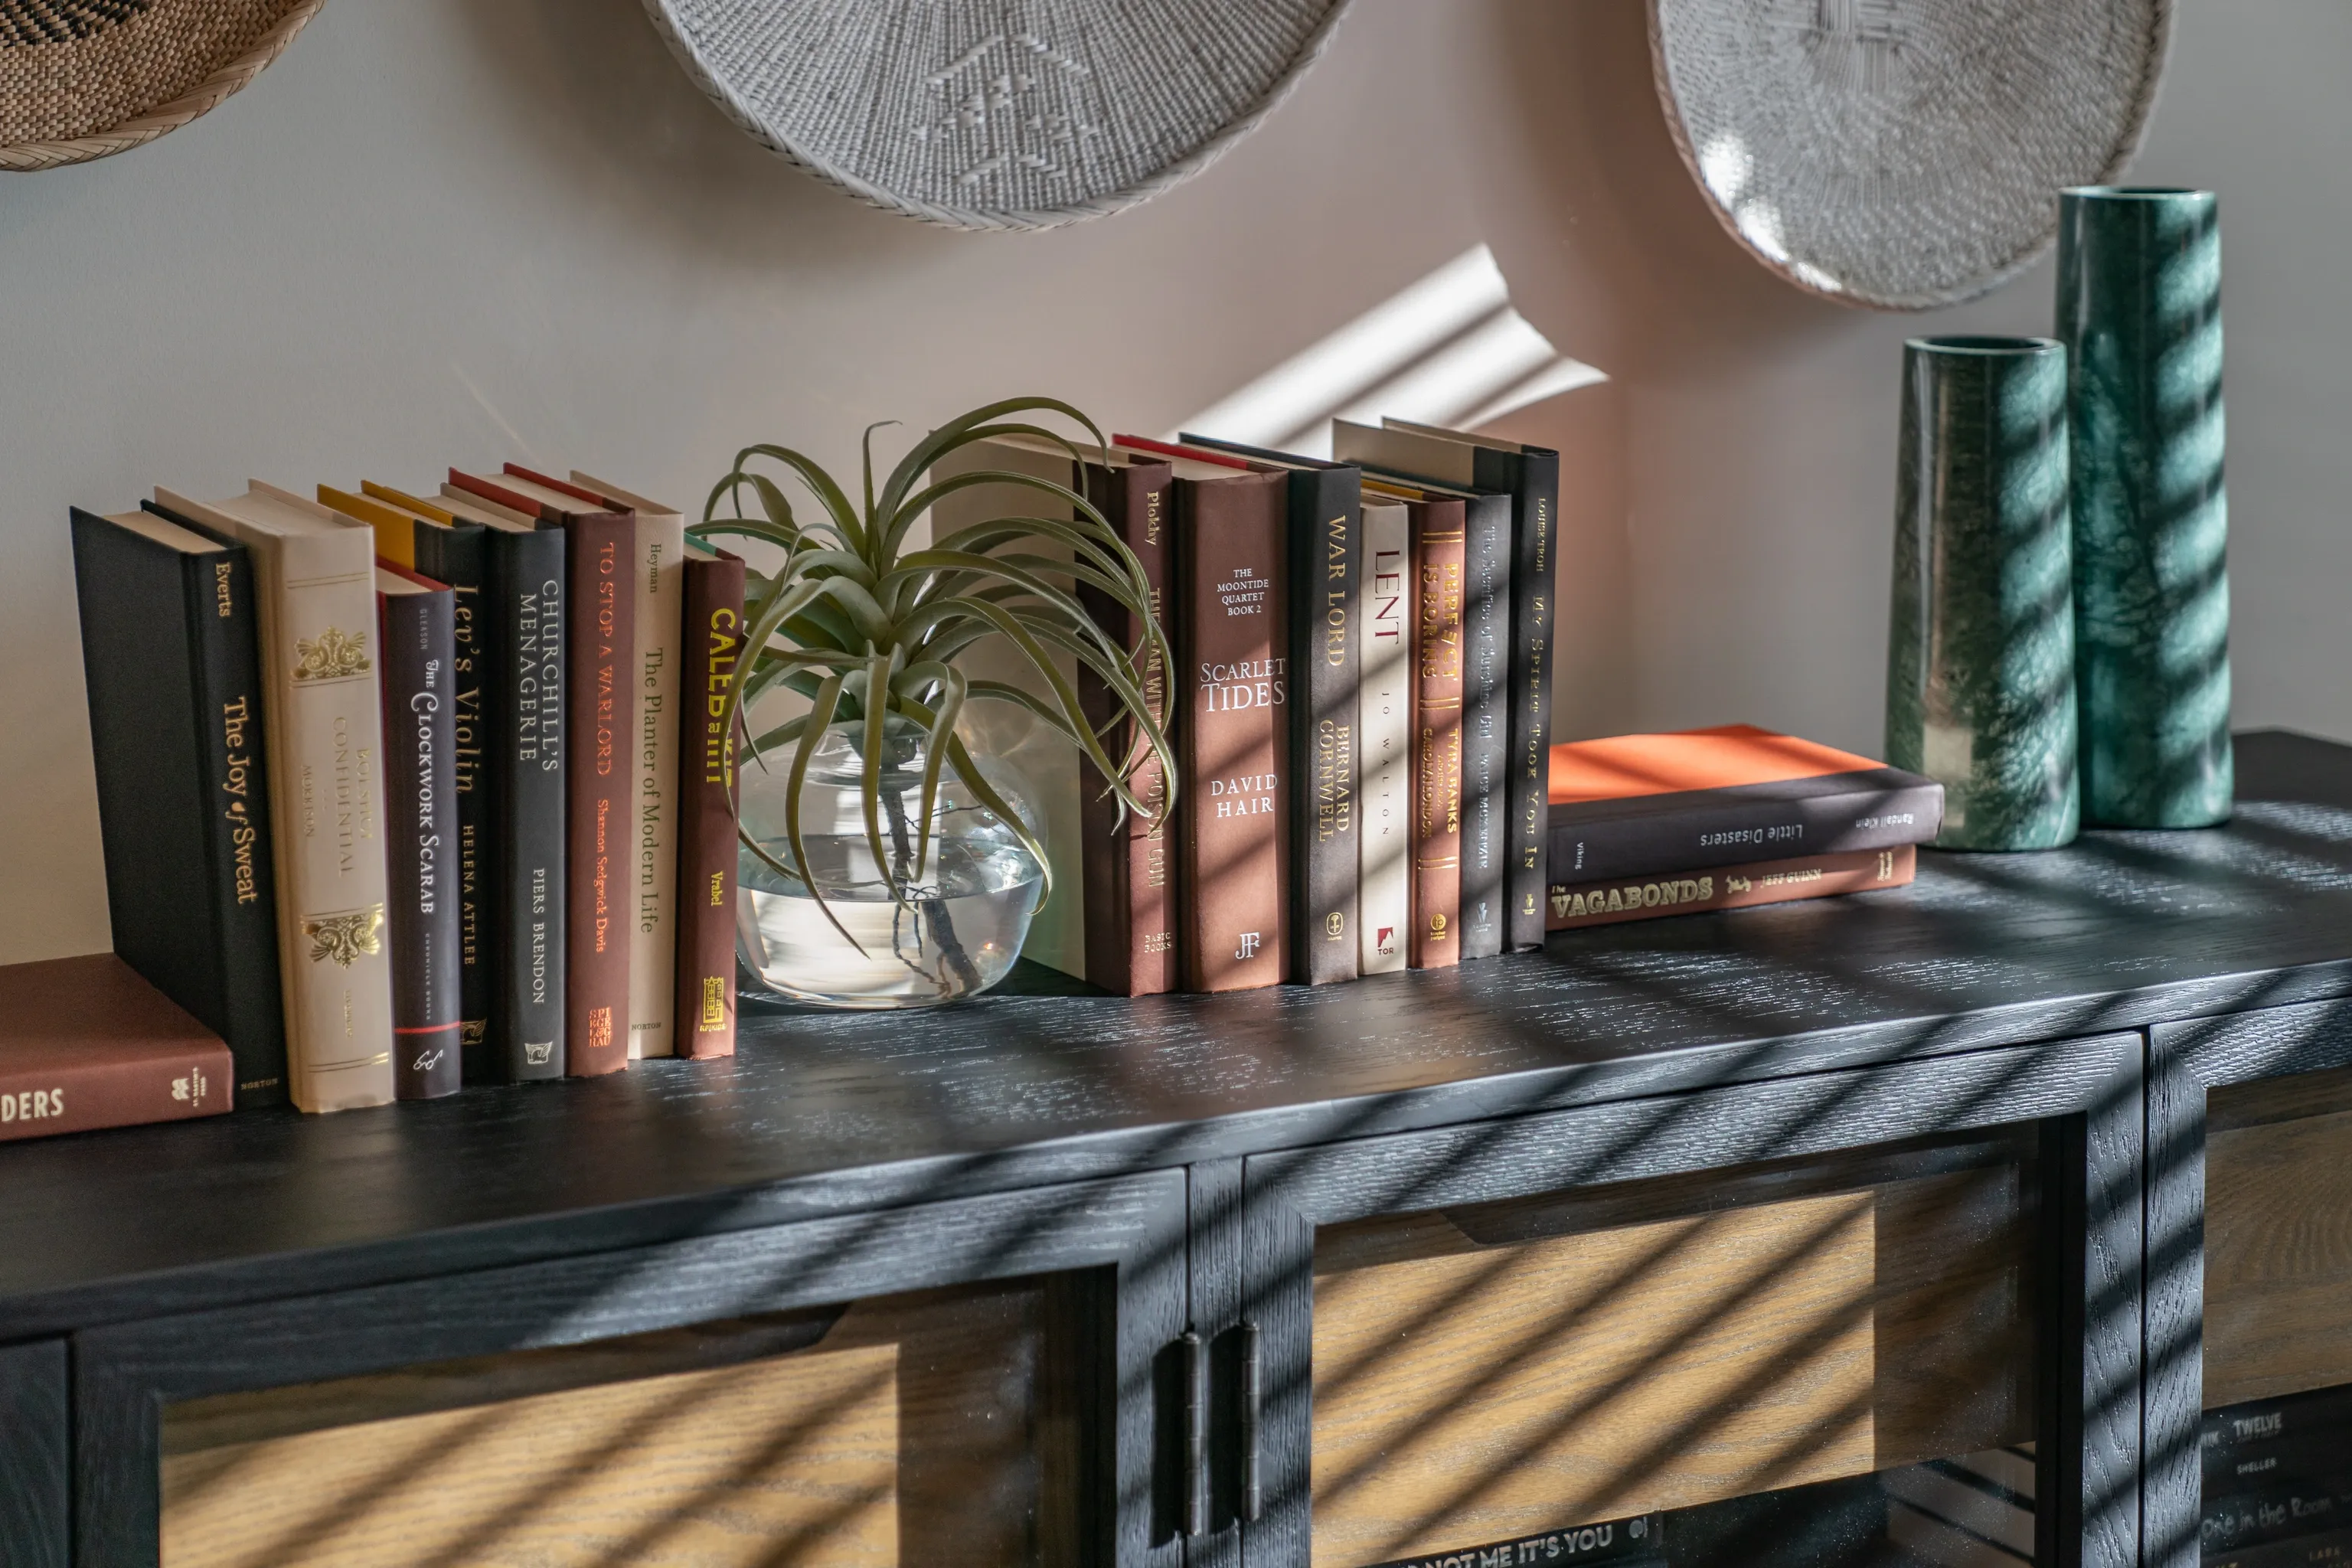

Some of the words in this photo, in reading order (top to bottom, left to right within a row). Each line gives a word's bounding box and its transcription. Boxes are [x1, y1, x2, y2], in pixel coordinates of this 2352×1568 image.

[1145, 492, 1160, 546] Plokhy
[599, 541, 614, 575] TO
[649, 543, 662, 593] Heyman
[1328, 514, 1346, 582] WAR
[215, 562, 230, 617] Everts
[1217, 579, 1269, 593] MOONTIDE
[1233, 568, 1253, 578] THE
[1423, 564, 1439, 583] IS
[599, 580, 614, 638] STOP
[1221, 592, 1265, 606] QUARTET
[1227, 606, 1254, 616] BOOK
[1256, 605, 1262, 613] 2
[1374, 550, 1400, 645] LENT
[1533, 596, 1544, 627] MY
[419, 609, 428, 650] GLEASON
[454, 584, 481, 673] Lev's
[1328, 590, 1345, 666] LORD
[1423, 593, 1439, 678] BORING
[1442, 563, 1459, 681] PERFECT
[598, 644, 612, 659] A
[645, 647, 663, 688] The
[1200, 658, 1286, 683] SCARLET
[520, 593, 537, 760] MENAGERIE
[542, 580, 558, 771] CHURCHILL'S
[1200, 681, 1285, 712] TIDES
[224, 696, 250, 748] The
[596, 664, 612, 776] WARLORD
[1381, 691, 1390, 714] JO
[454, 687, 482, 794] Violin
[643, 694, 662, 771] Planter
[1447, 728, 1459, 774] TYRA
[1527, 724, 1540, 779] TOOK
[222, 755, 250, 797] Joy
[410, 692, 439, 829] CLOCKWORK
[1319, 719, 1334, 843] CORNWELL
[1336, 724, 1350, 832] BERNARD
[301, 765, 315, 838] MORRISON
[332, 717, 354, 878] CONFIDENTIAL
[642, 777, 661, 799] of
[1210, 773, 1278, 796] DAVID
[1446, 776, 1458, 834] BANKS
[596, 799, 609, 854] Shannon
[1216, 796, 1273, 818] HAIR
[1422, 786, 1433, 838] LONDON
[1526, 789, 1539, 835] YOU
[1856, 817, 1878, 829] Klein
[1880, 812, 1914, 828] Randall
[642, 803, 660, 887] Modern
[1700, 828, 1762, 846] Disasters
[1768, 824, 1803, 841] Little
[233, 826, 259, 905] Sweat
[419, 835, 440, 913] SCARAB
[462, 825, 475, 894] HELENA
[1148, 848, 1165, 887] GUN
[1524, 846, 1537, 869] IN
[1575, 842, 1584, 870] Viking
[533, 867, 545, 914] PIERS
[593, 856, 608, 916] Sedgwick
[710, 871, 724, 907] Vrabel
[1551, 877, 1713, 918] VAGABONDS
[1552, 885, 1566, 893] The
[1760, 874, 1785, 888] JEFF
[1786, 868, 1822, 884] GUINN
[463, 901, 475, 965] ATTLEE
[641, 892, 658, 934] Life
[596, 918, 608, 952] Davis
[1145, 933, 1171, 943] BASIC
[1145, 942, 1171, 953] BOOKS
[1378, 947, 1394, 956] TOR
[532, 922, 544, 1004] BRENDON
[631, 1021, 662, 1031] NORTON
[0, 1087, 64, 1122] DERS
[2232, 1413, 2282, 1436] TWELVE
[2259, 1503, 2287, 1528] the
[1480, 1545, 1512, 1568] ME
[1518, 1535, 1560, 1564] IT'S
[1565, 1524, 1613, 1553] YOU
